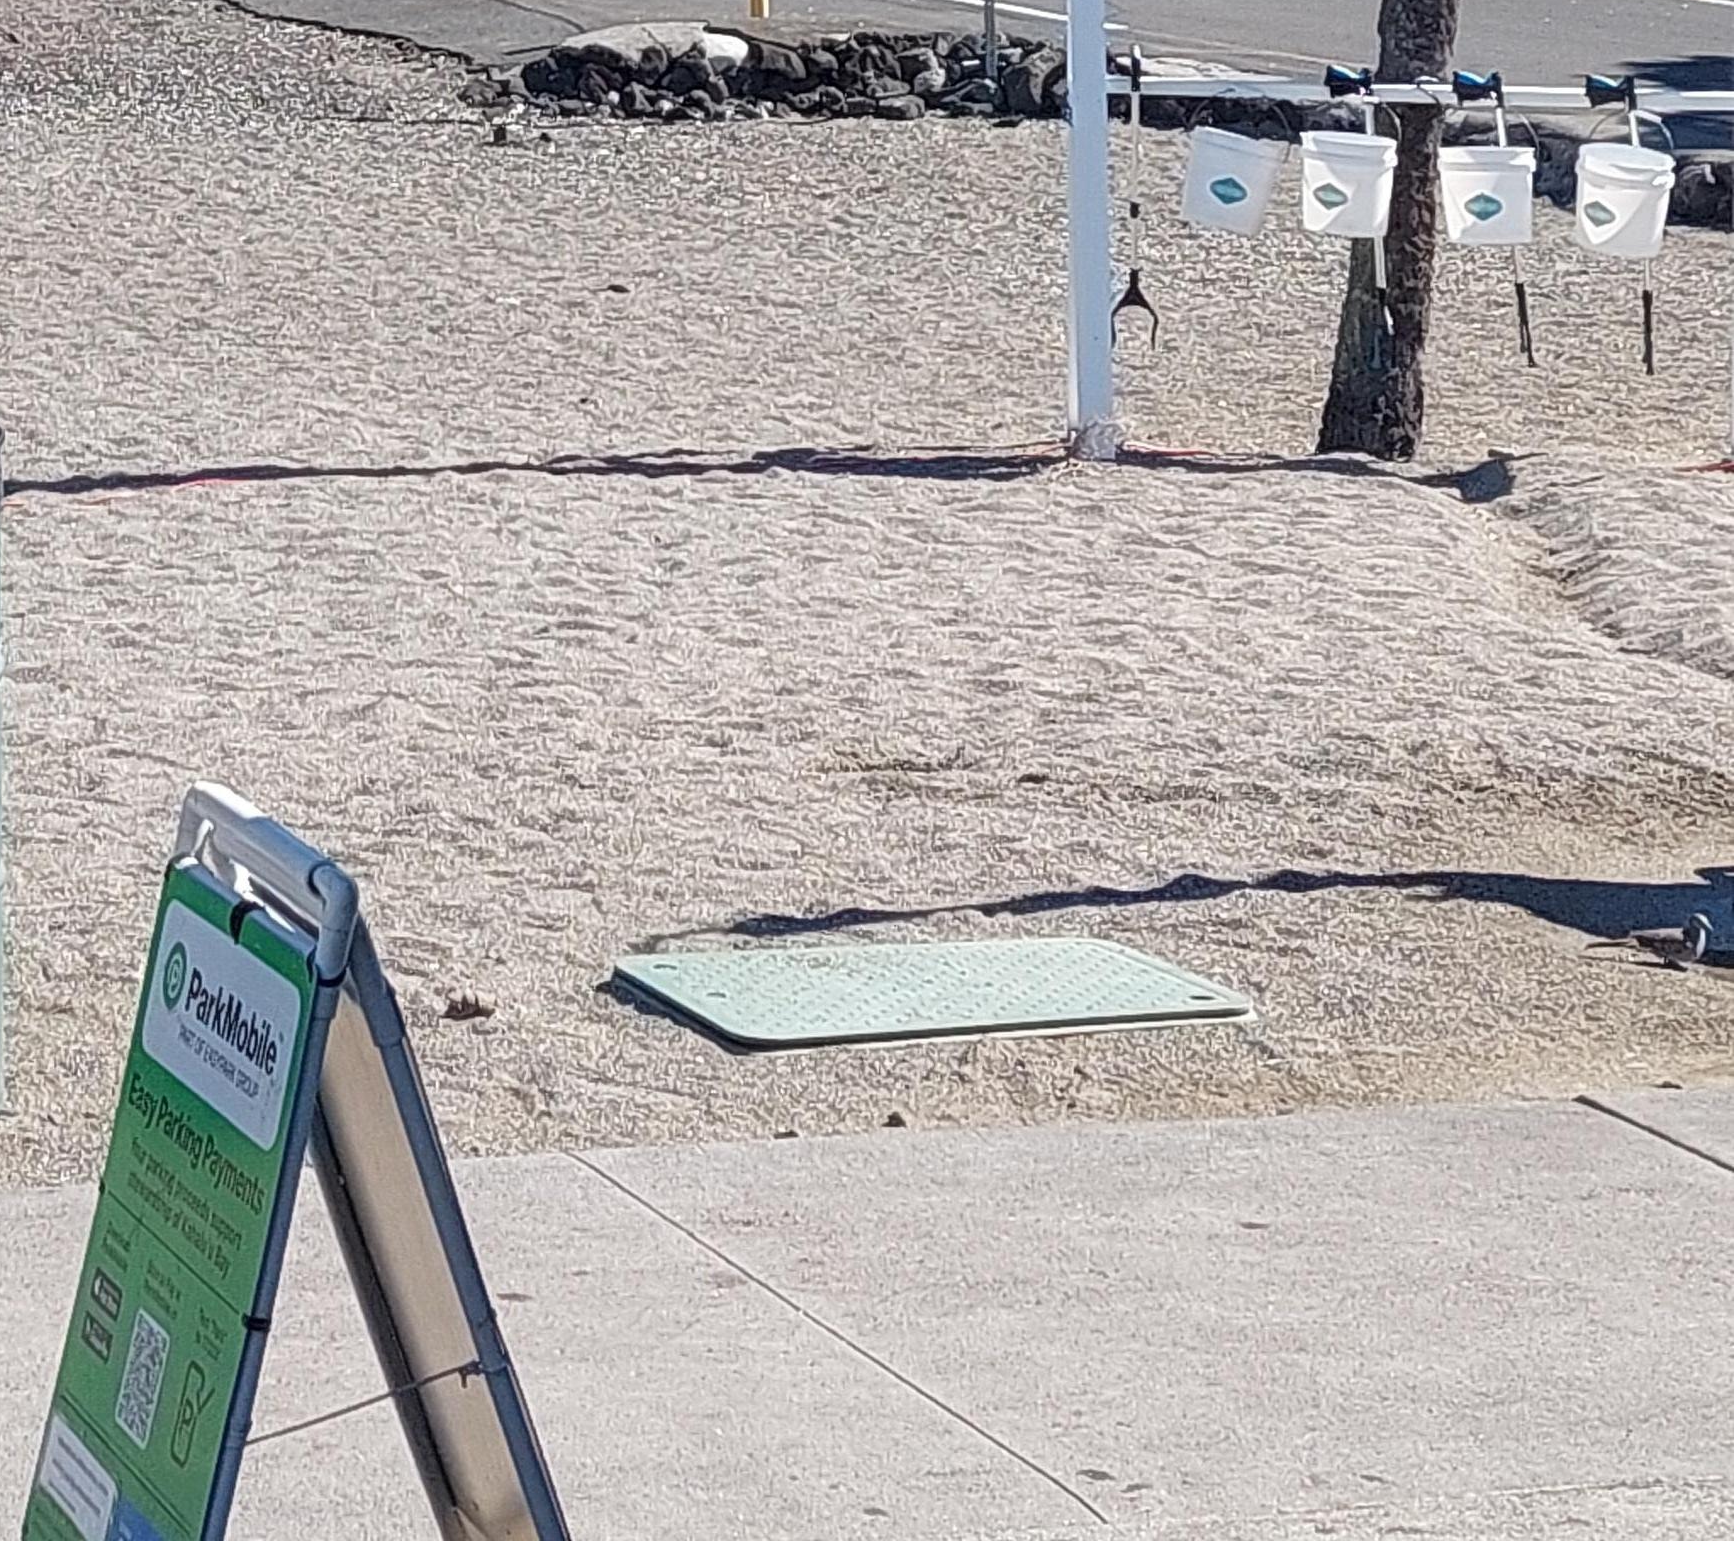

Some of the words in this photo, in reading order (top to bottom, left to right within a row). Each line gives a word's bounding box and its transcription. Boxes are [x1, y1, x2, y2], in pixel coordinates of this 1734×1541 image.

[185, 966, 278, 1076] ParkMobile
[128, 1072, 158, 1130] Easy
[156, 1095, 203, 1170] Parking
[202, 1133, 265, 1217] Payments
